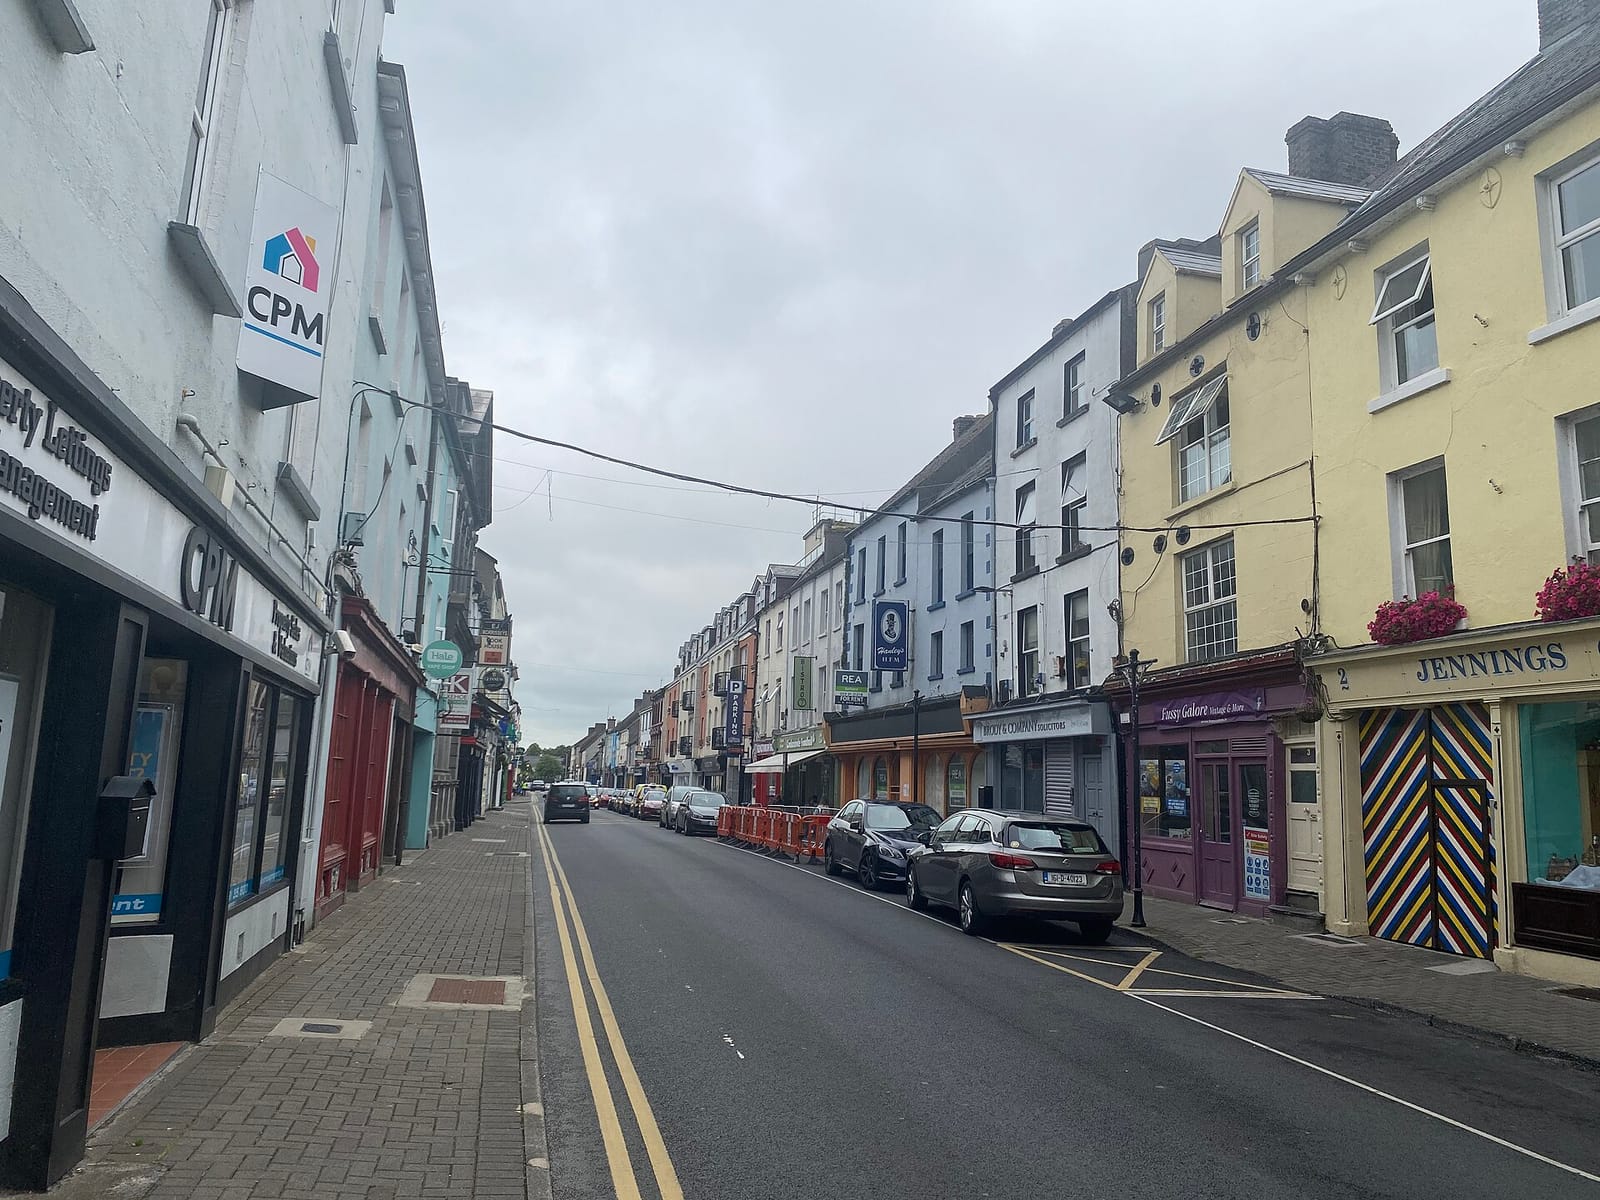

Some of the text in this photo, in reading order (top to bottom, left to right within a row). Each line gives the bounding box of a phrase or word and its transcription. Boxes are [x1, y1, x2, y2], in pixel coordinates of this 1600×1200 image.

[247, 286, 324, 346] CPM
[42, 400, 112, 495] Lettings
[181, 526, 239, 631] CPM
[841, 674, 863, 684] REA
[1337, 667, 1349, 686] 2
[1416, 642, 1567, 682] JENNINGS
[449, 675, 469, 693] K
[732, 682, 740, 692] P
[731, 694, 739, 735] PARKING
[1037, 721, 1066, 731] SOLICITORS
[1161, 707, 1181, 722] Fussy
[1182, 702, 1208, 718] Galore
